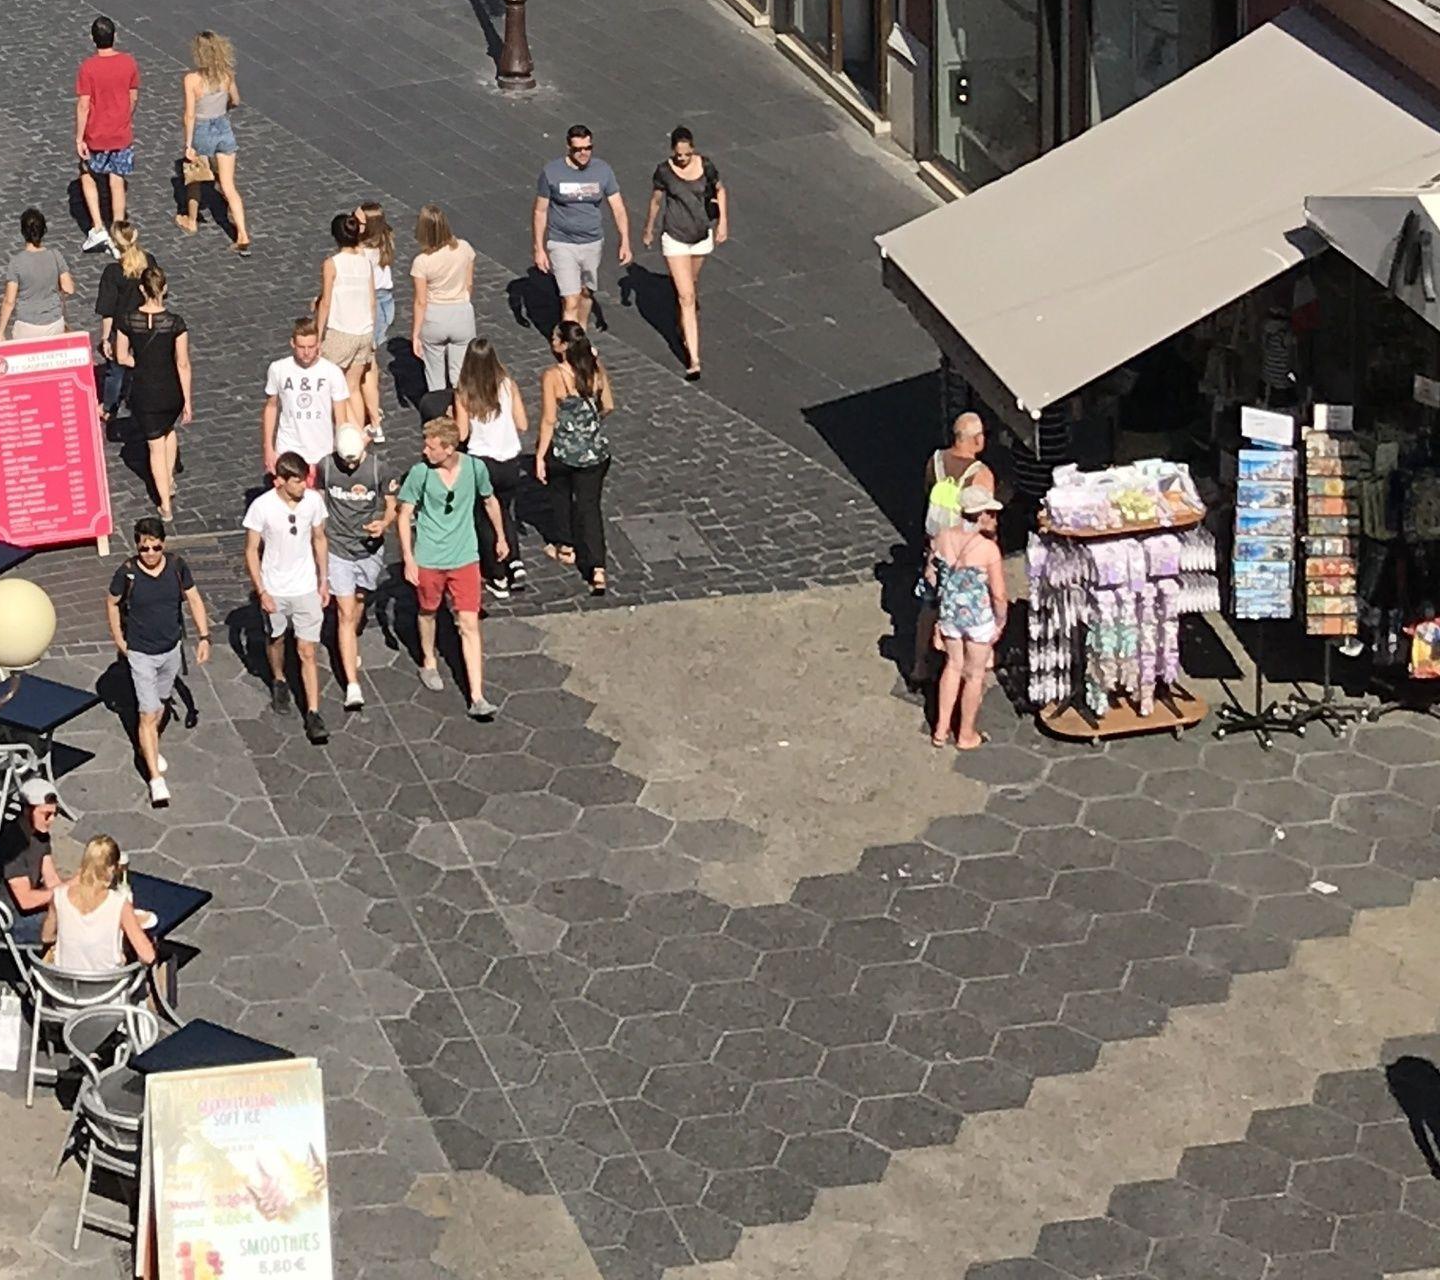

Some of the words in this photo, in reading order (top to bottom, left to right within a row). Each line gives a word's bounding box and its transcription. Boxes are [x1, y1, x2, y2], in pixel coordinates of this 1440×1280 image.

[283, 376, 294, 391] A
[299, 377, 311, 391] &
[316, 378, 326, 391] F
[239, 1232, 321, 1256] SMOOTHIES
